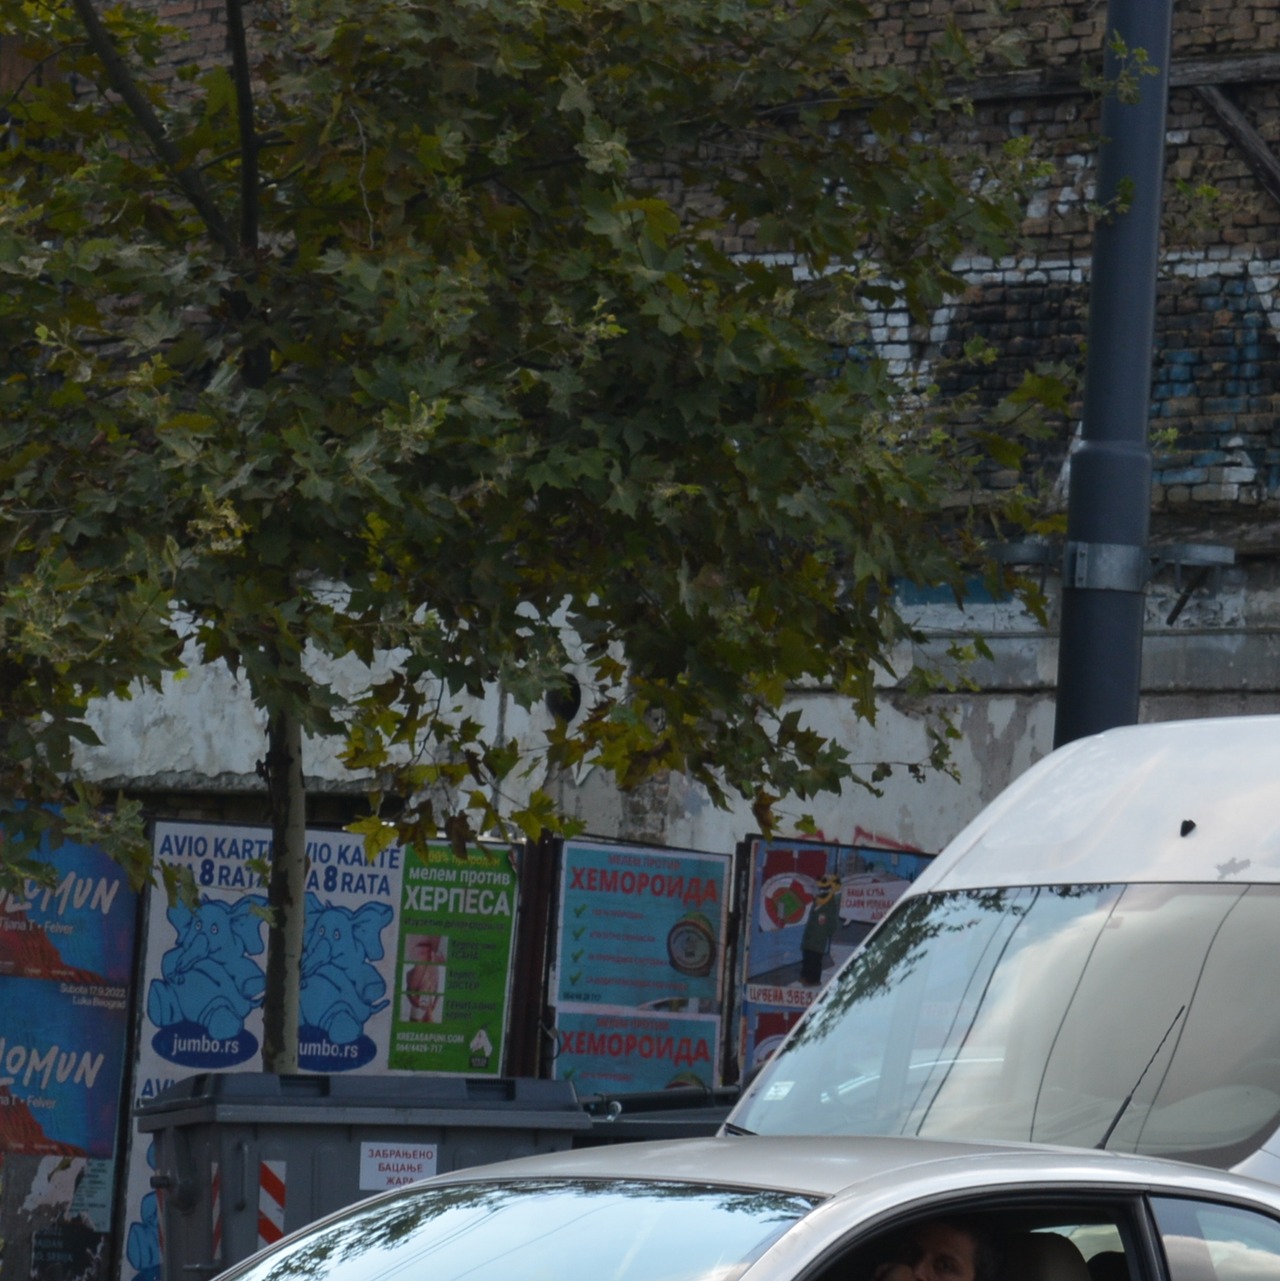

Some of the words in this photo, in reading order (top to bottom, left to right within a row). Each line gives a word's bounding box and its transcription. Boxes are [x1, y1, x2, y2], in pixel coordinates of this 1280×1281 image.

[159, 835, 208, 857] AVIO
[306, 842, 331, 864] IO
[428, 850, 449, 861] 00%
[199, 859, 214, 886] 8
[218, 865, 264, 888] RAT
[307, 870, 320, 891] A
[323, 865, 338, 892] 8
[341, 872, 391, 896] RATA
[409, 867, 457, 883] мелем
[460, 869, 511, 887] против
[570, 866, 718, 907] ХЕМОРОИДА
[404, 884, 511, 917] ХЕРПЕСА
[786, 986, 818, 1004] ЗВЕЗ
[171, 1033, 240, 1056] jumbo.rs
[299, 1036, 359, 1058] umbo.rs
[561, 1031, 710, 1067] ХЕМОРОИДА
[141, 1078, 175, 1099] AV
[368, 1149, 433, 1160] ЗАБРАЊЕНО
[378, 1163, 424, 1173] БАЦАЊЕ
[386, 1176, 414, 1186] ЖАРА
